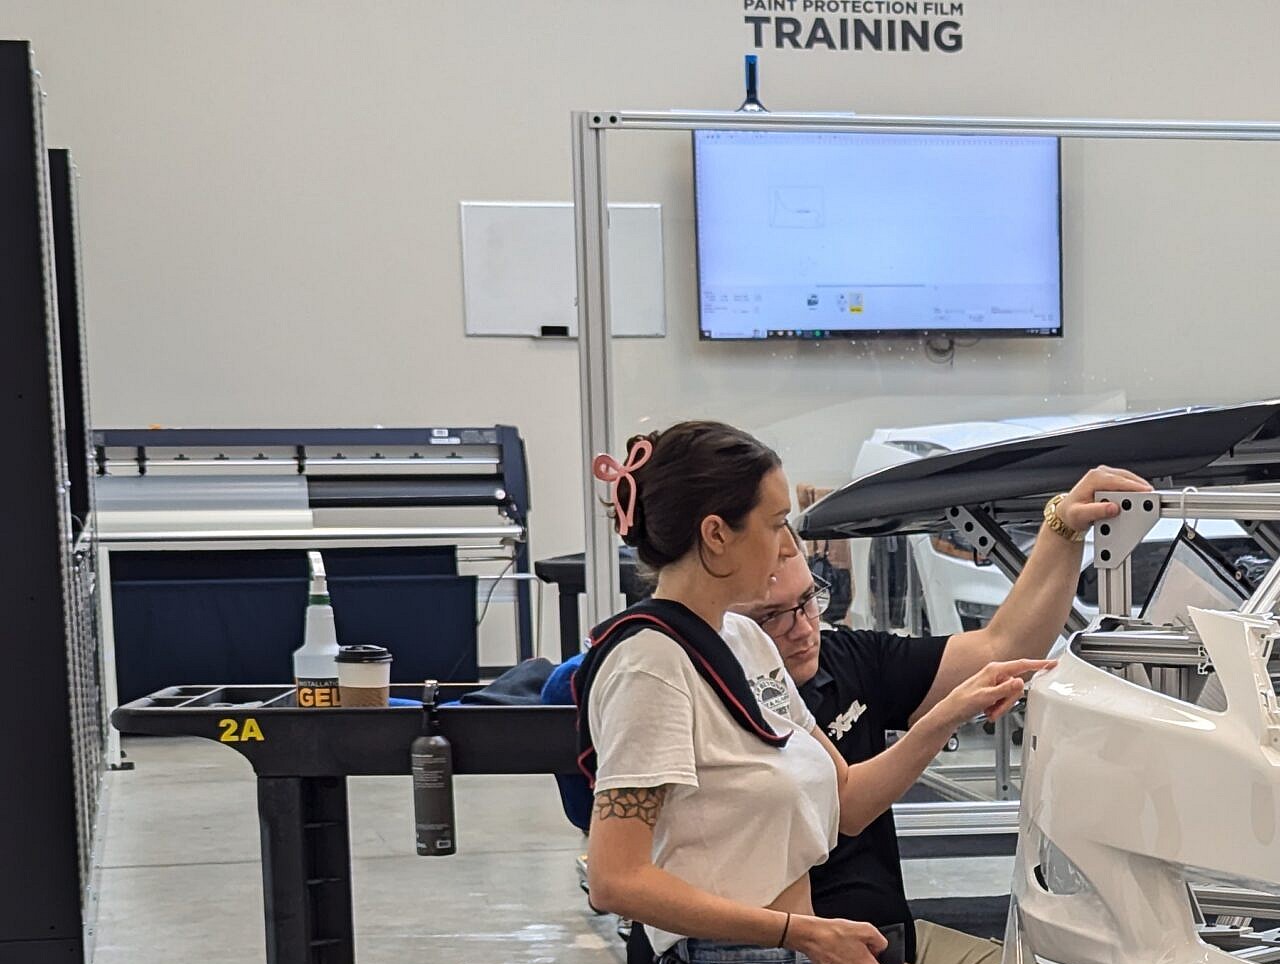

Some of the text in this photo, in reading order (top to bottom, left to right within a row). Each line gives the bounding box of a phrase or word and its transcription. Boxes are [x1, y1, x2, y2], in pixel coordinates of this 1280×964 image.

[744, 0, 964, 16] PAINT PROTECTION FILM
[744, 16, 964, 53] TRAINING
[299, 687, 341, 707] GEL
[218, 718, 265, 742] 2A
